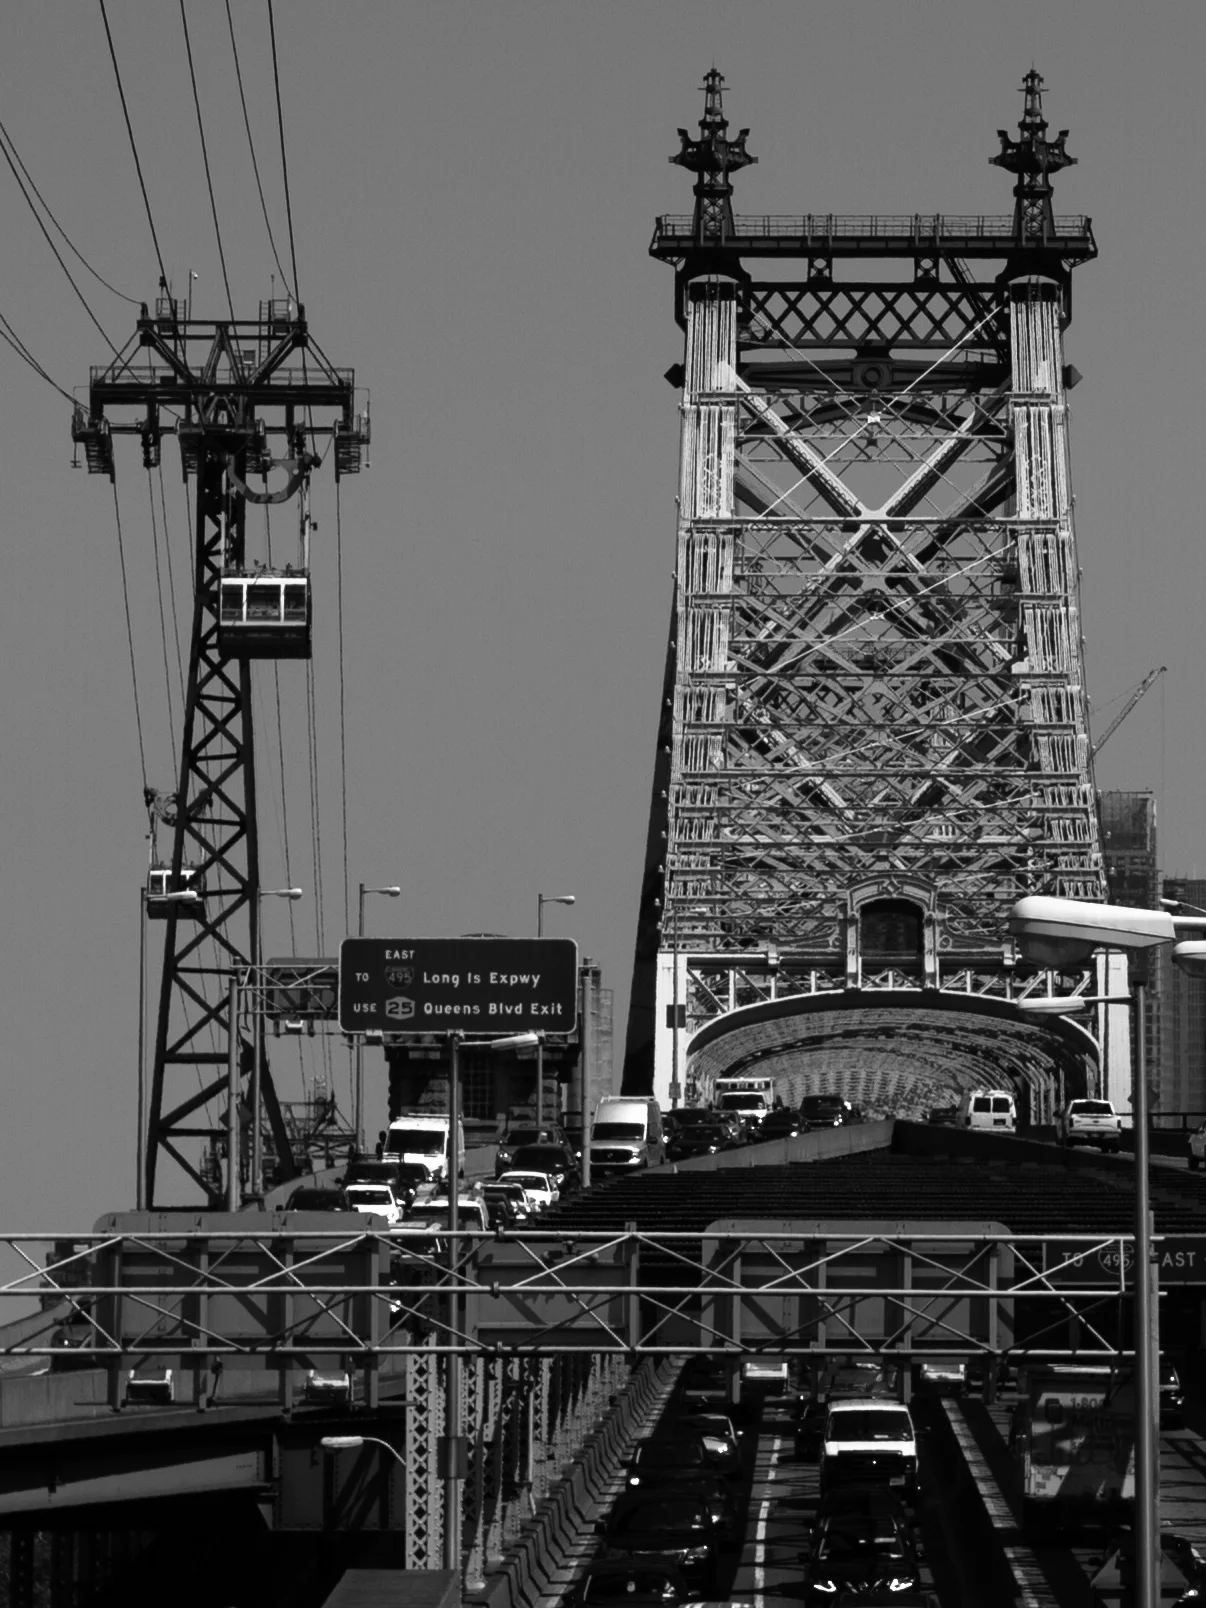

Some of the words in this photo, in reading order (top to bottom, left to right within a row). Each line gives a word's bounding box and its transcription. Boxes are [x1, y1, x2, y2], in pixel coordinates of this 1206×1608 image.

[385, 949, 415, 960] EAST
[355, 972, 370, 982] TO
[388, 972, 413, 984] 495
[423, 972, 460, 988] Long
[467, 972, 482, 984] Is
[489, 972, 541, 988] Expwy
[353, 1003, 377, 1013] USE
[387, 1002, 413, 1015] 25
[423, 1003, 481, 1015] Queens
[488, 1003, 523, 1015] Blvd
[530, 1003, 563, 1015] Exit
